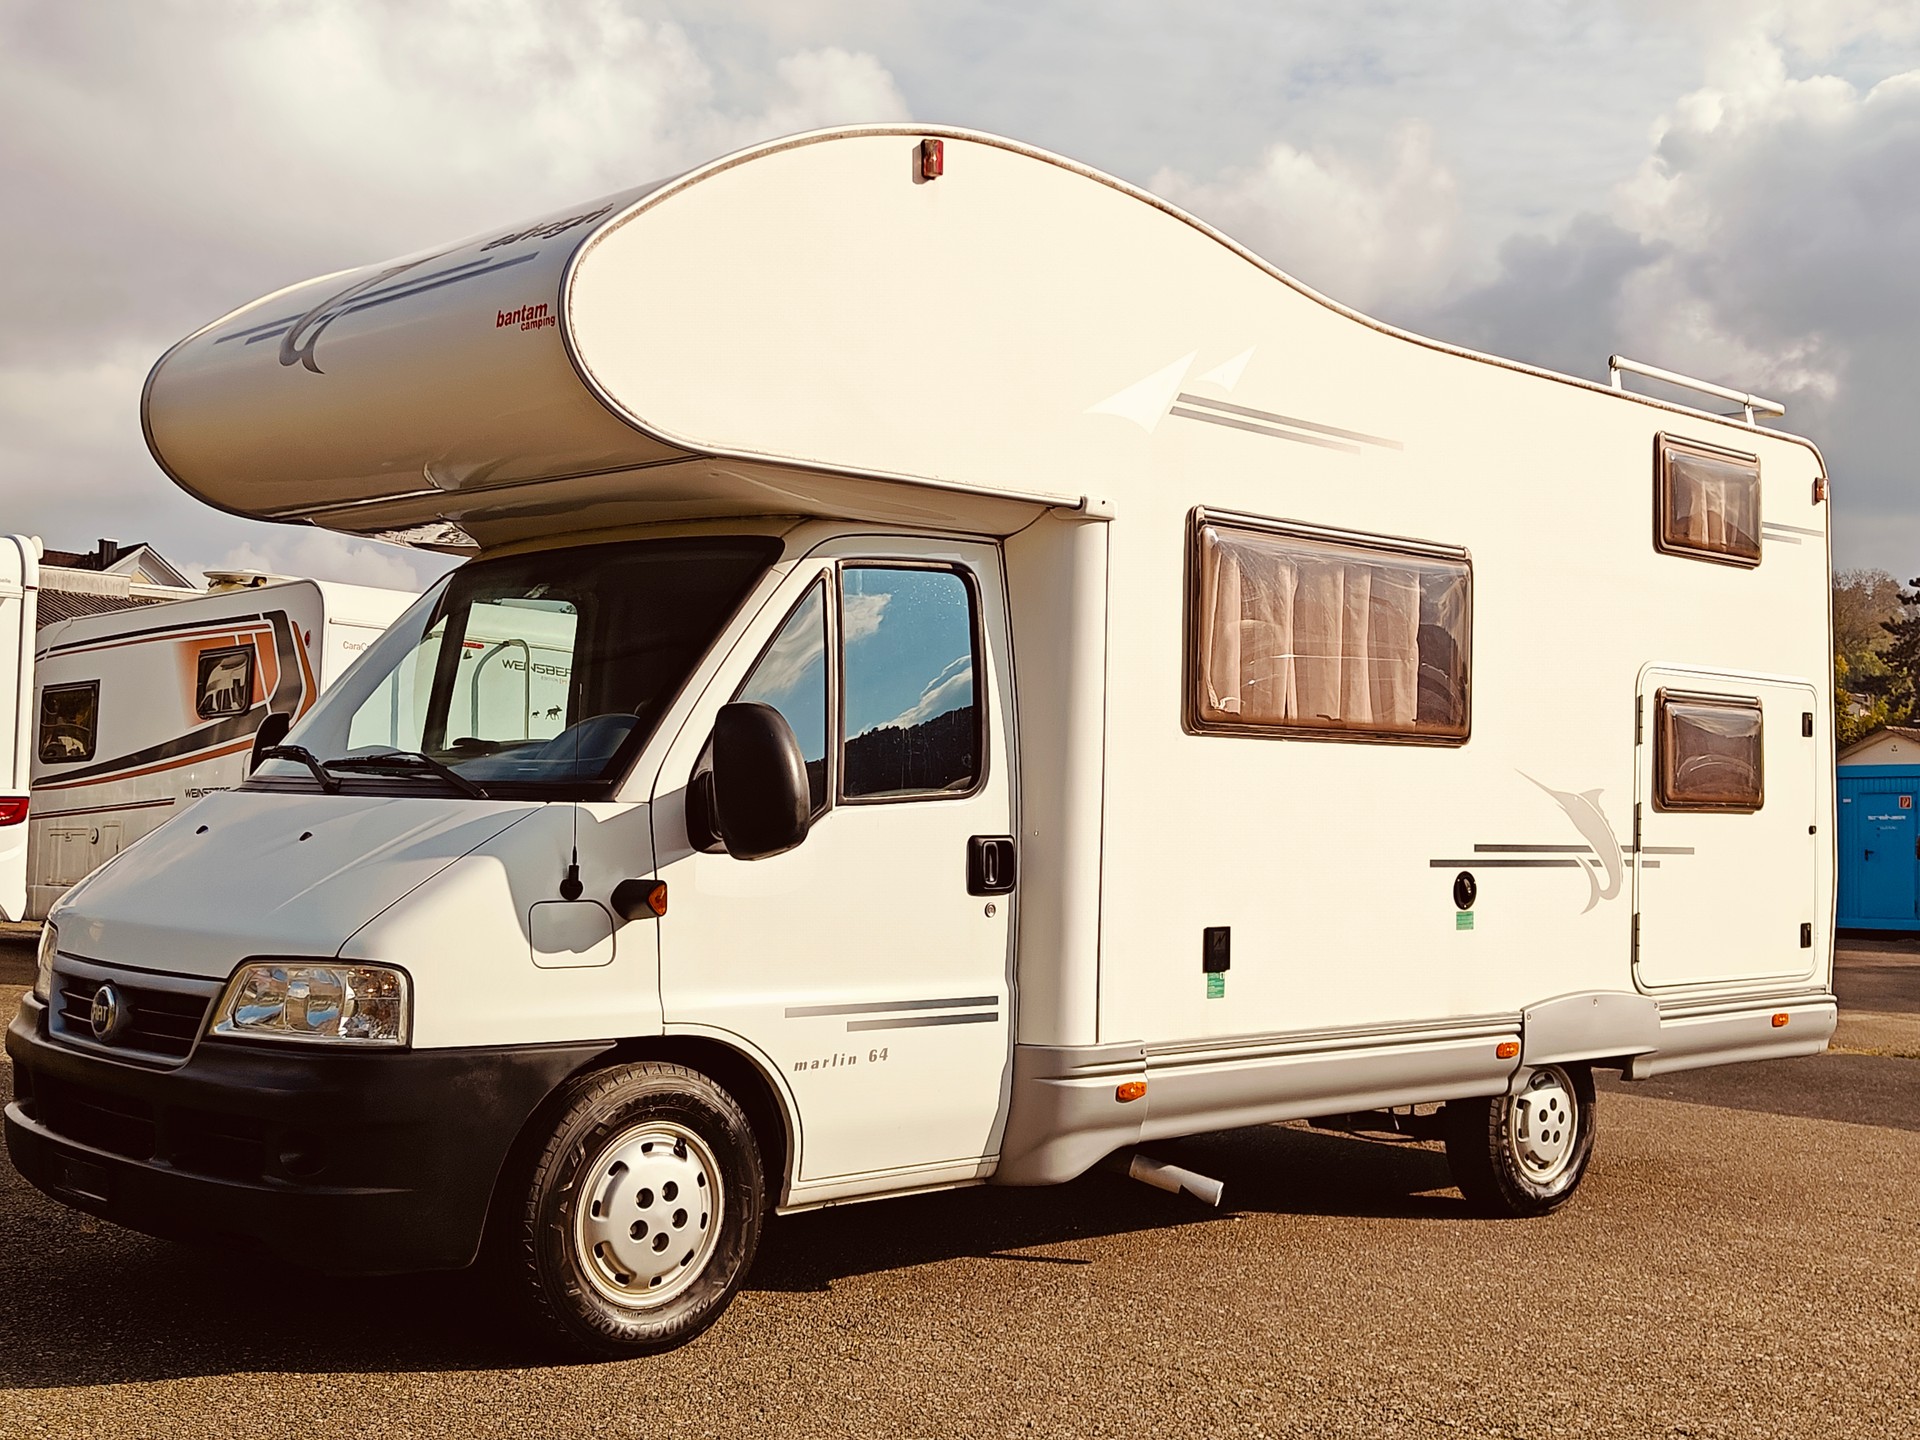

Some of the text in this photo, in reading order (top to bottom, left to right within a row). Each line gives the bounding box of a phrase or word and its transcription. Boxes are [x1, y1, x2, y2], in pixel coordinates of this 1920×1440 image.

[496, 303, 548, 328] bantam
[521, 316, 556, 331] camping
[794, 1047, 889, 1071] marlin 64
